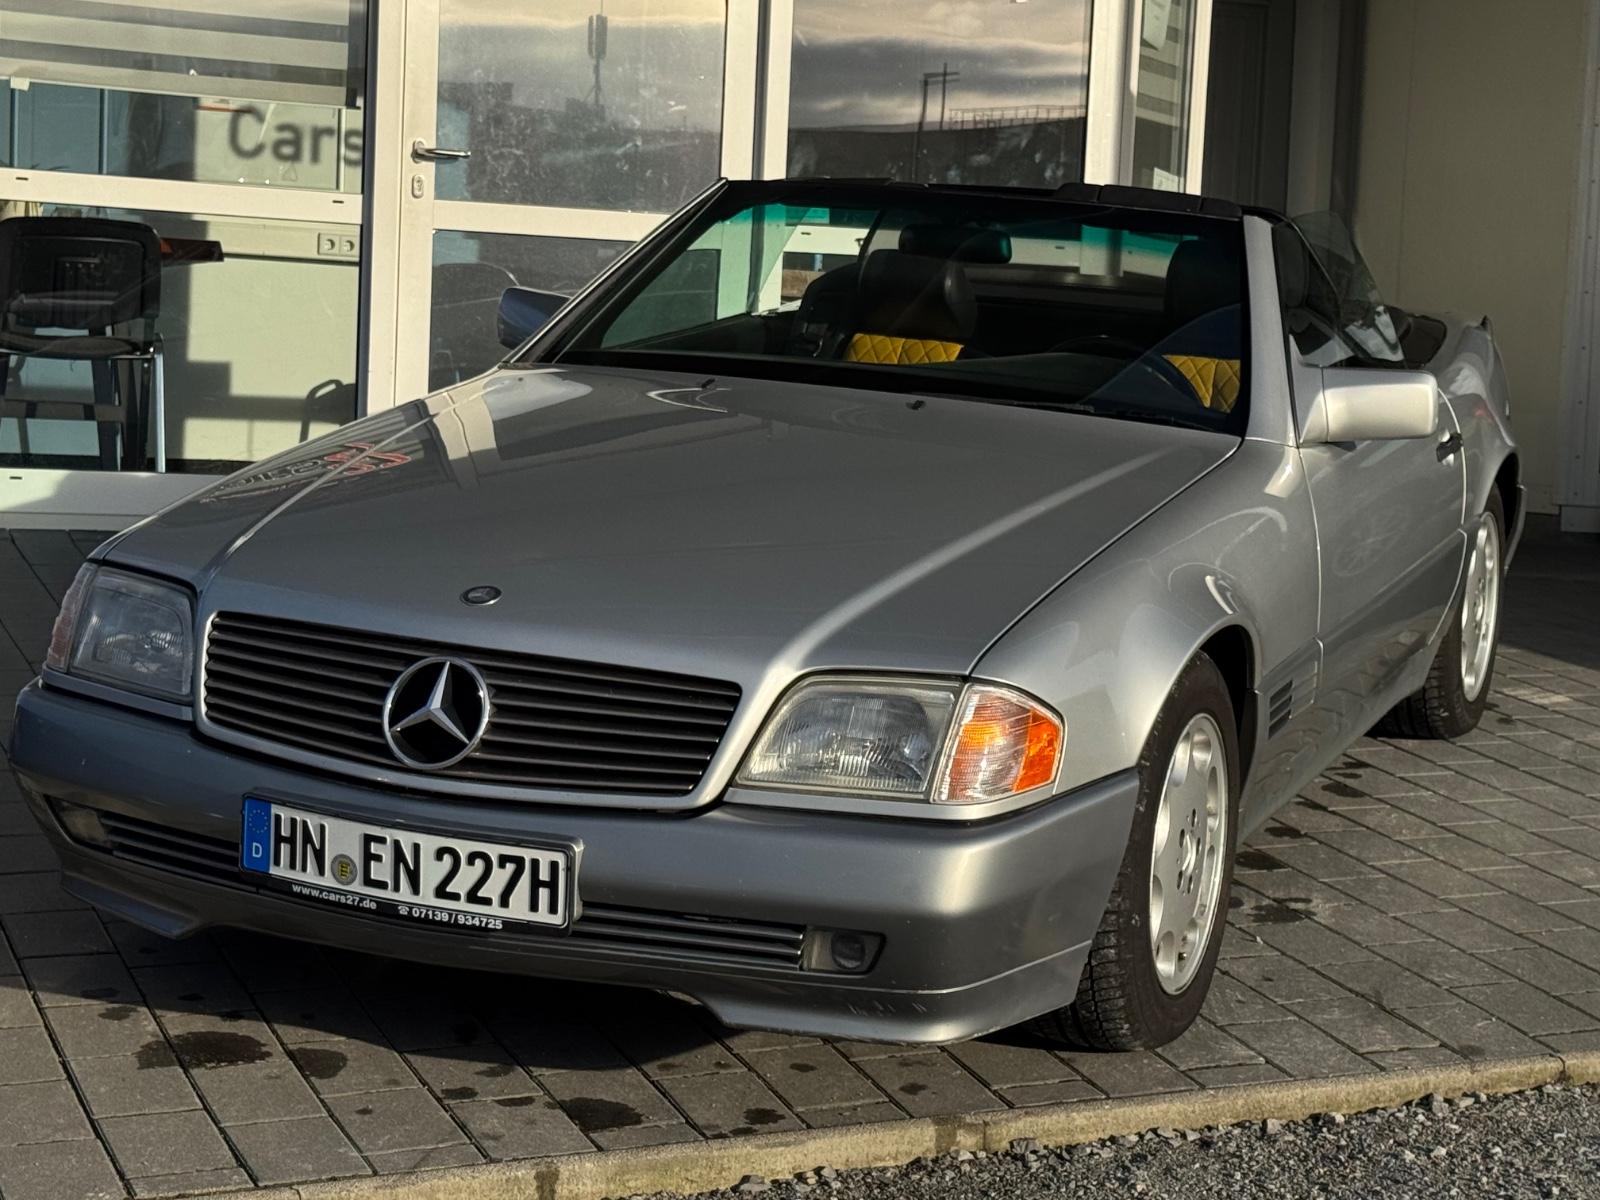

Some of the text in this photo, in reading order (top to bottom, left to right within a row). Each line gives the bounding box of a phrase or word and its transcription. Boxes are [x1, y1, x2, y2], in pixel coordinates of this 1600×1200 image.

[228, 104, 363, 167] Cars
[252, 842, 263, 858] D
[273, 813, 560, 915] HN EN 227H
[292, 884, 377, 909] www.cars27.de
[412, 907, 449, 922] 07139
[457, 914, 503, 930] 934725
